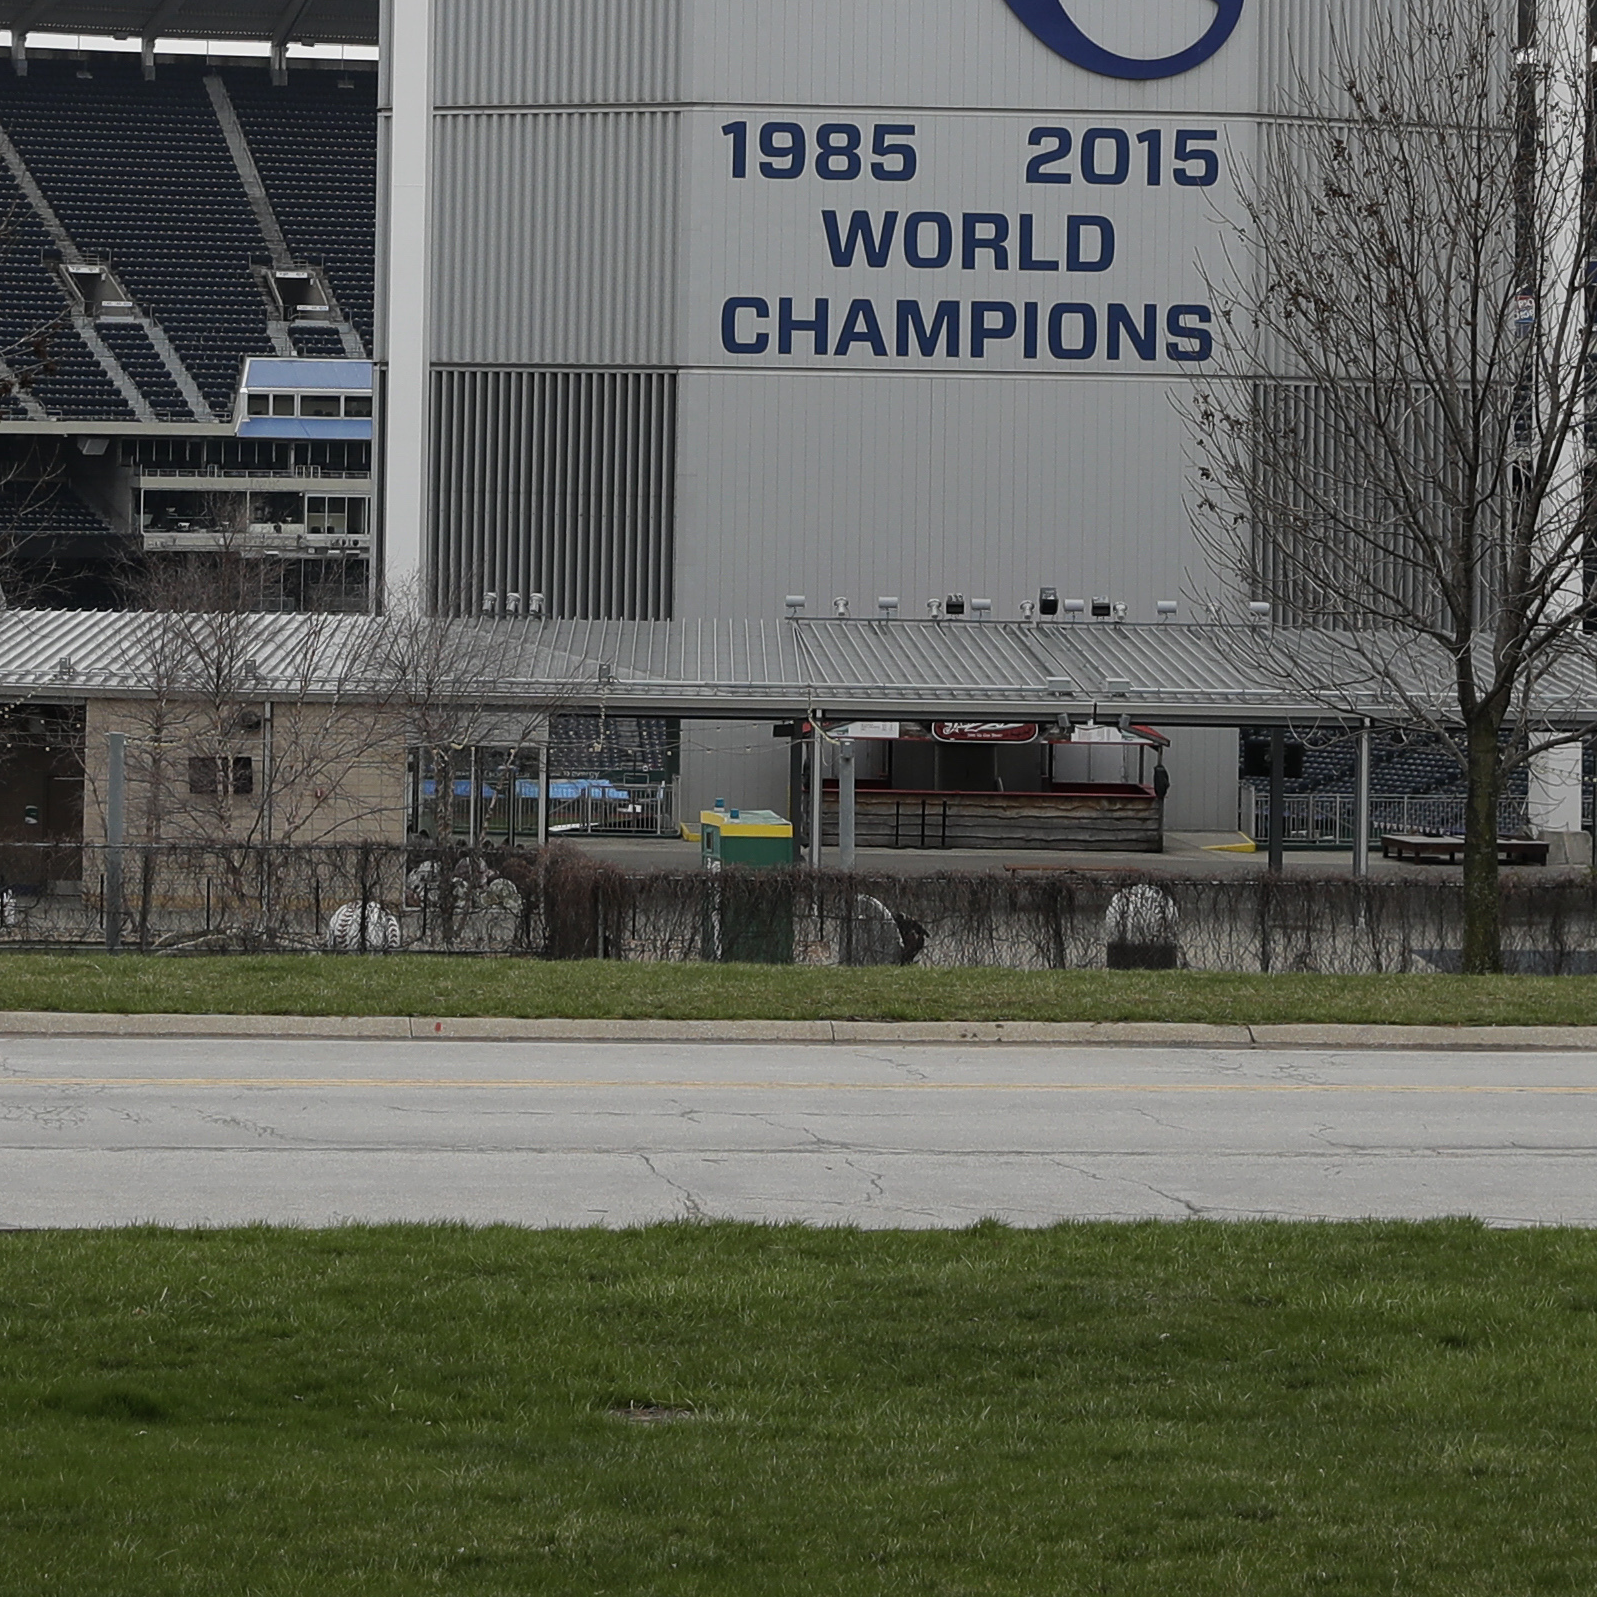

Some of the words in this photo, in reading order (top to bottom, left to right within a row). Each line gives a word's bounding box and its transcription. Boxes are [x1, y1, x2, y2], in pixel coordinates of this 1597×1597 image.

[722, 121, 917, 181] 1985
[1026, 127, 1219, 186] 2015
[822, 210, 1115, 272] WORLD
[721, 297, 1213, 361] CHAMPIONS
